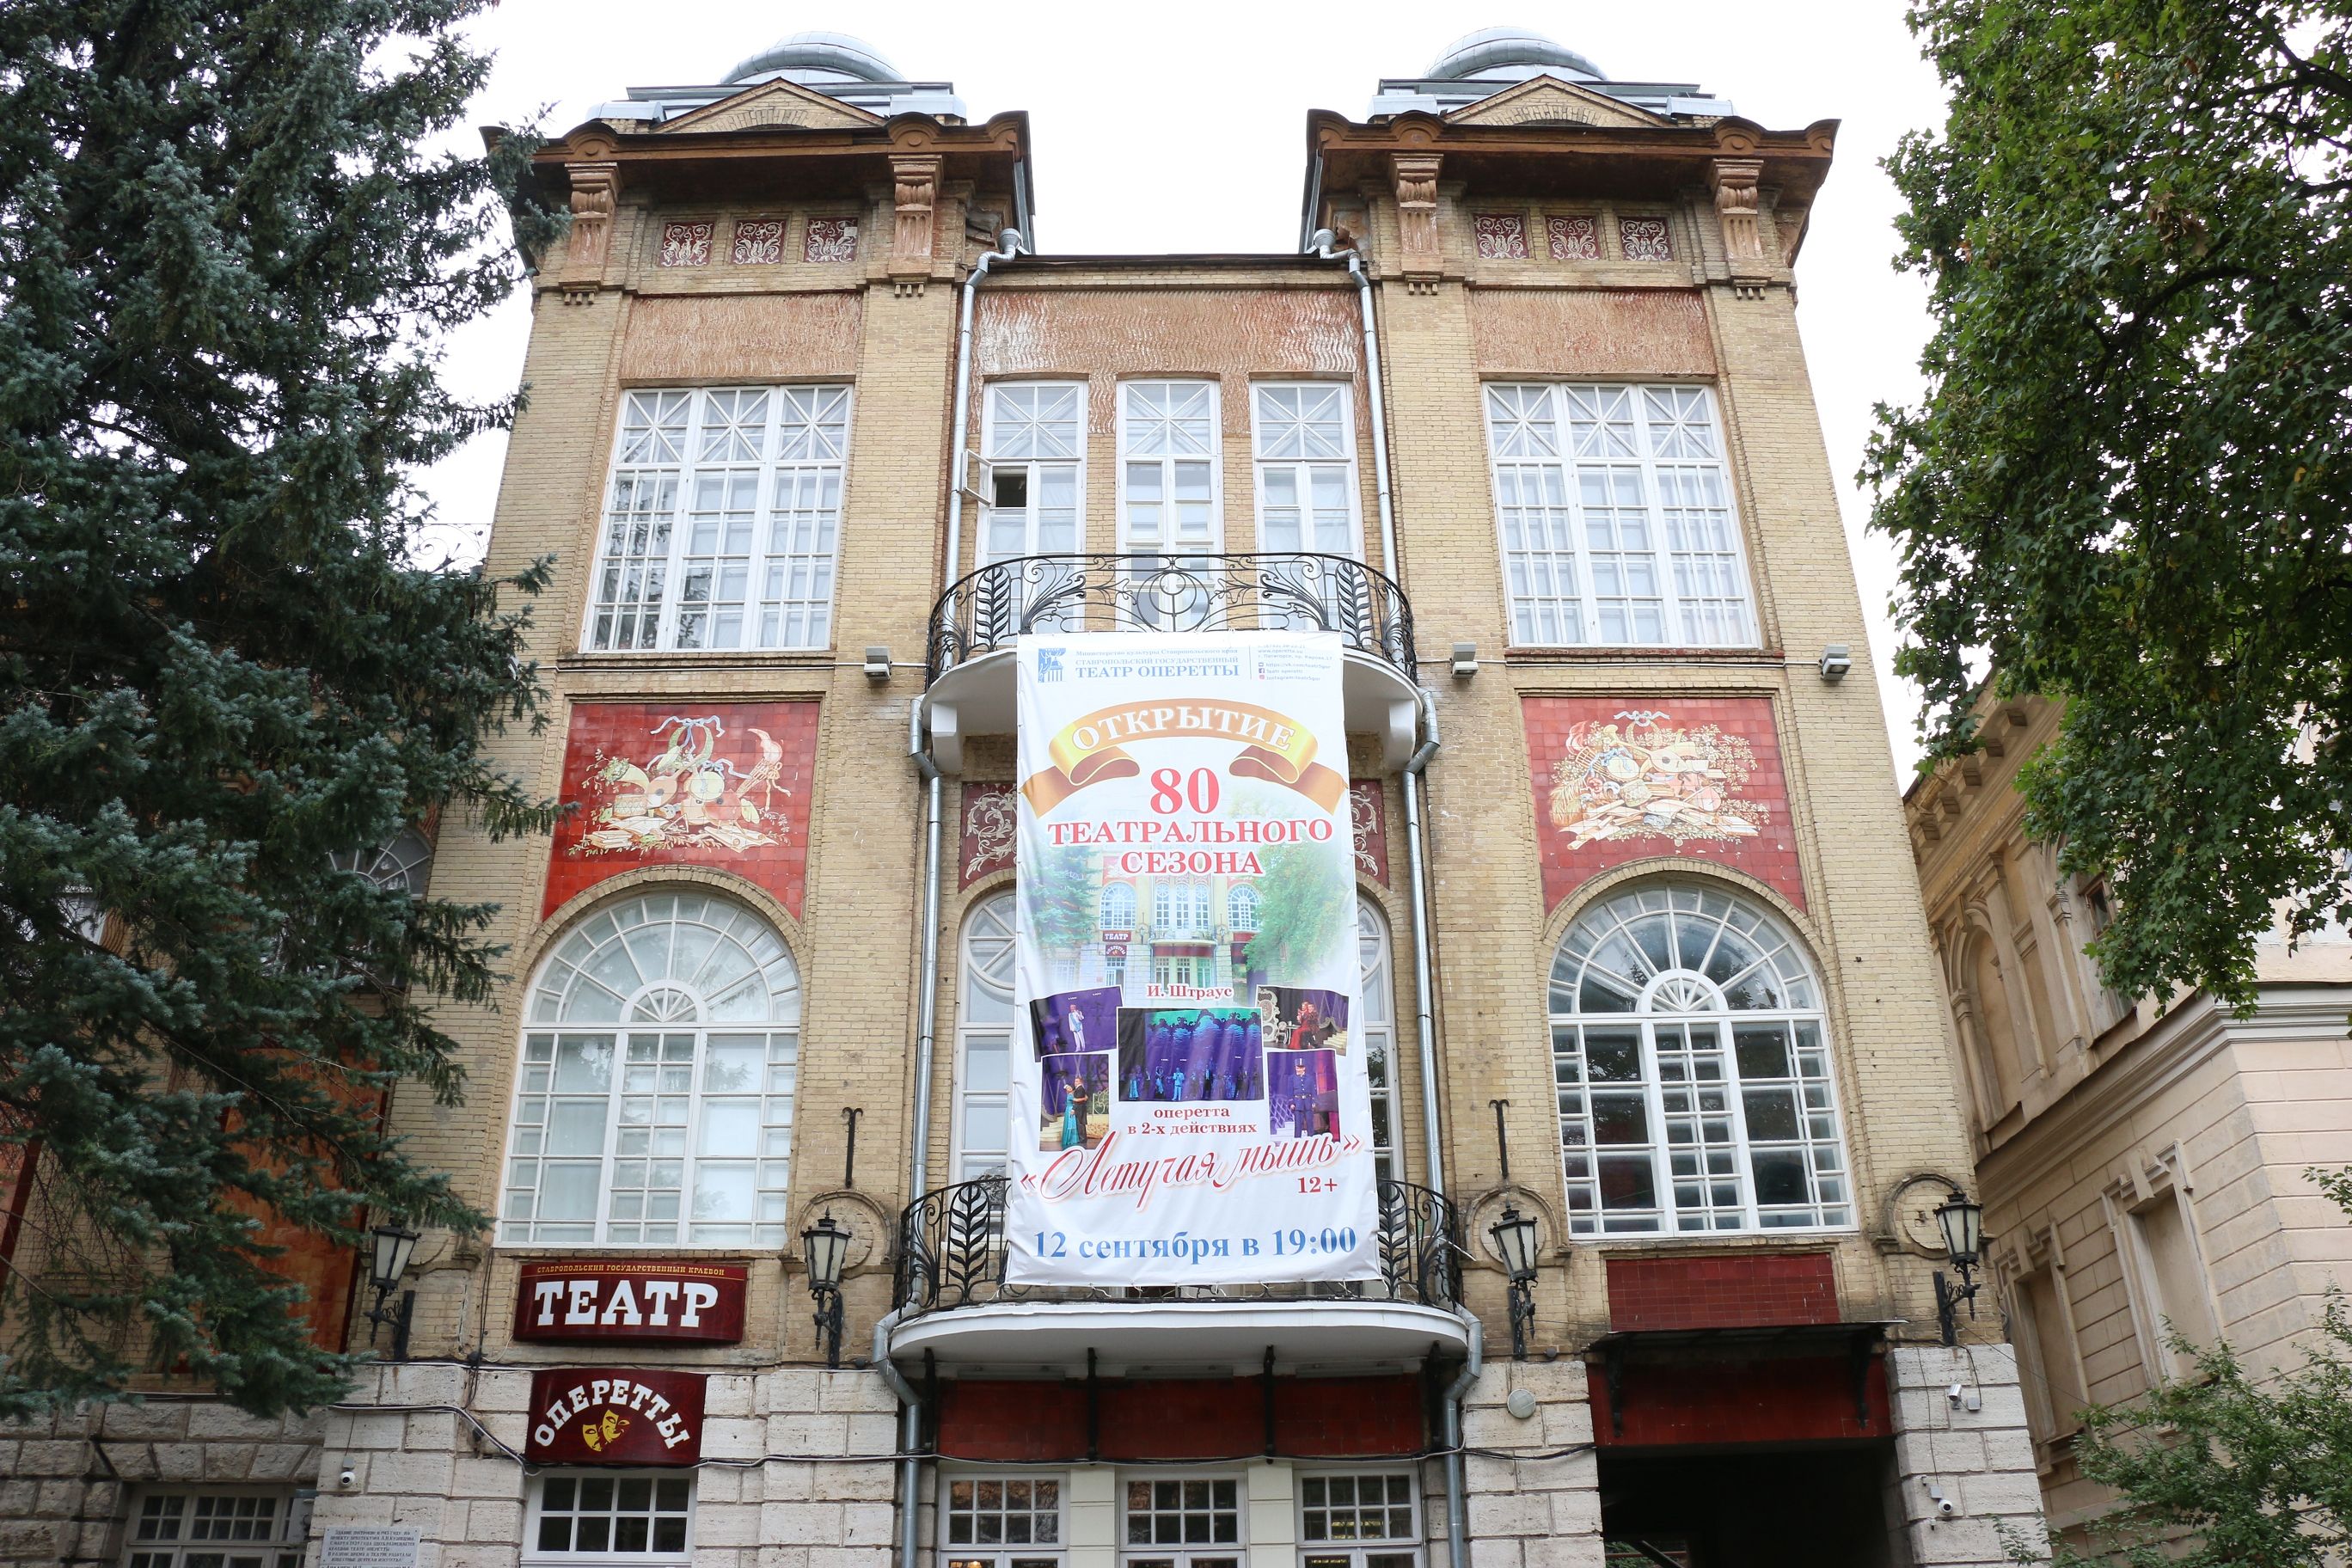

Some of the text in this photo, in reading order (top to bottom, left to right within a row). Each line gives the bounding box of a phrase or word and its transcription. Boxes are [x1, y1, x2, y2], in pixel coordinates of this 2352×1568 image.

[1075, 657, 1239, 666] СТАВРОПОЛЬСКИЙ ГОСУДАРСТВЕННЫЙ
[1075, 665, 1240, 678] ТЕАТР ОПЕРЕТТЫ
[1071, 706, 1295, 752] ОТКРЫТИЕ
[1150, 768, 1220, 815] 80
[1048, 818, 1332, 846] ТЕАТРАЛЬНОГО
[1121, 851, 1264, 874] СЕЗОНА
[1146, 985, 1233, 1001] И. Штраус
[1154, 1107, 1230, 1120] оперетта
[1128, 1121, 1257, 1136] в 2-х действиях
[1298, 1176, 1338, 1193] 12+
[1034, 1227, 1357, 1265] 12 сентября в 19:00
[537, 1265, 725, 1276] СТАВРОПОЛЬСКИЙ ГОСУДАРСТВЕННЫЙ КРАЕВОЙ
[534, 1279, 719, 1328] ТЕАТР
[534, 1378, 690, 1449] ОПЕРЕТТЫ
